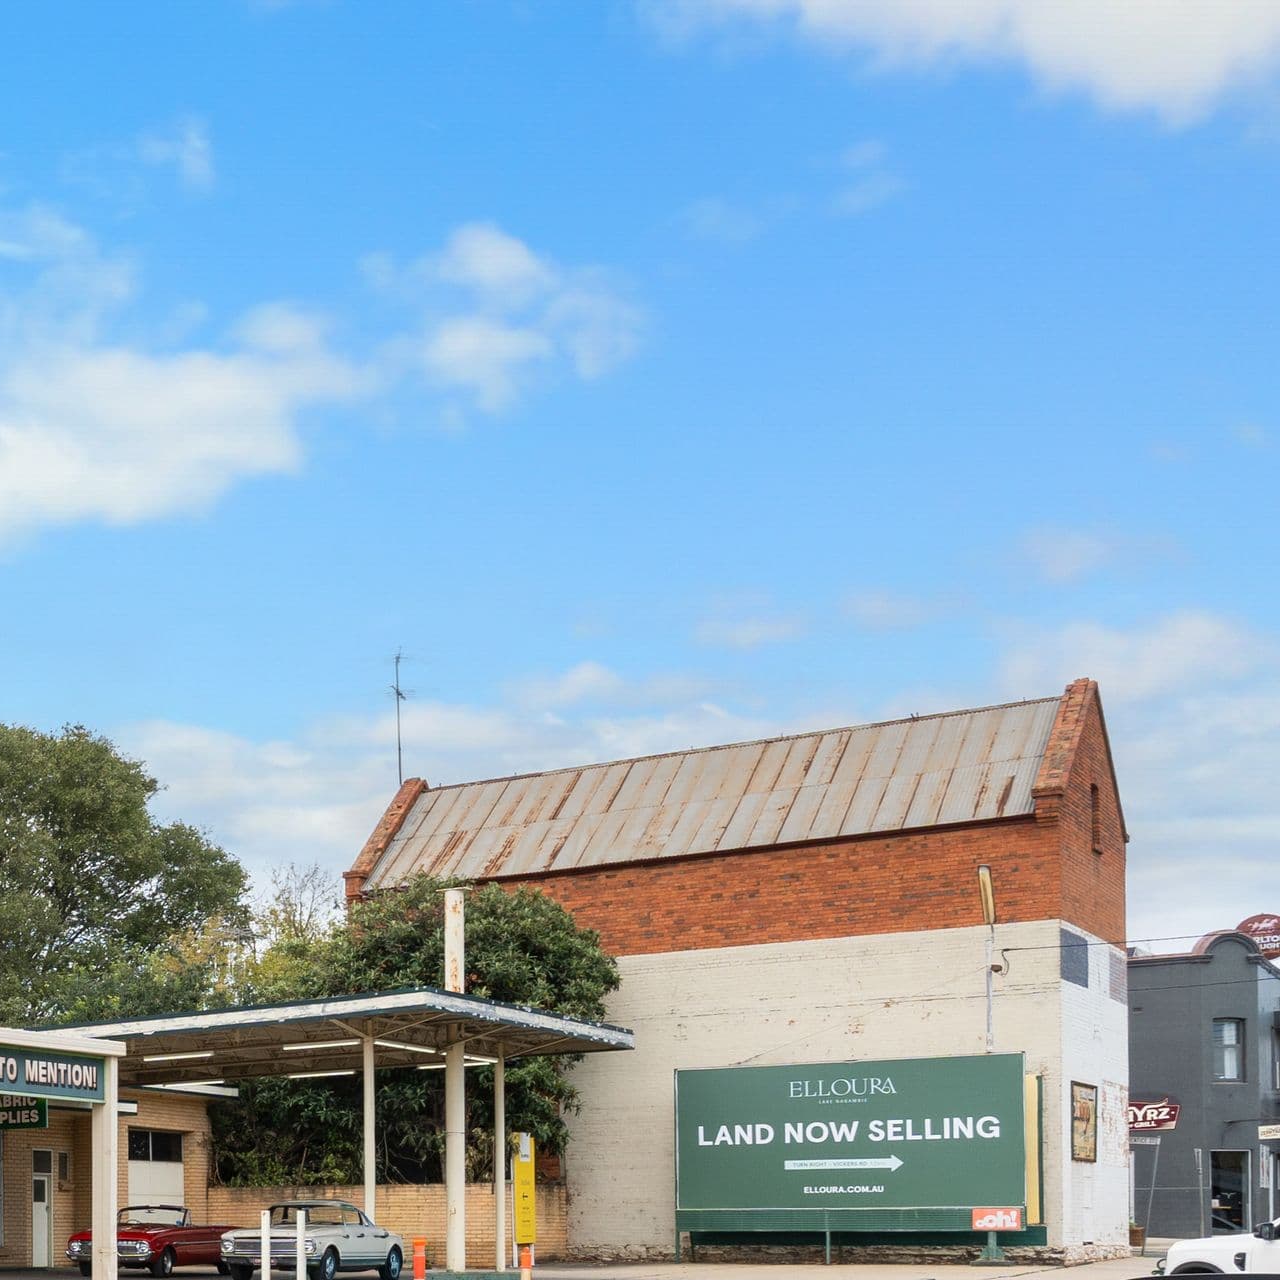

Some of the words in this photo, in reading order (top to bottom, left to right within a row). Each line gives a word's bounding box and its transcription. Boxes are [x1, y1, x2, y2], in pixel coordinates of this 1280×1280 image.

[25, 1059, 98, 1092] MENTION!
[789, 1077, 897, 1098] ELLOURA
[698, 1123, 775, 1147] LAND
[784, 1120, 859, 1144] NOW
[868, 1115, 1001, 1142] SELLING
[803, 1185, 885, 1194] ELLOURA.COM.AU
